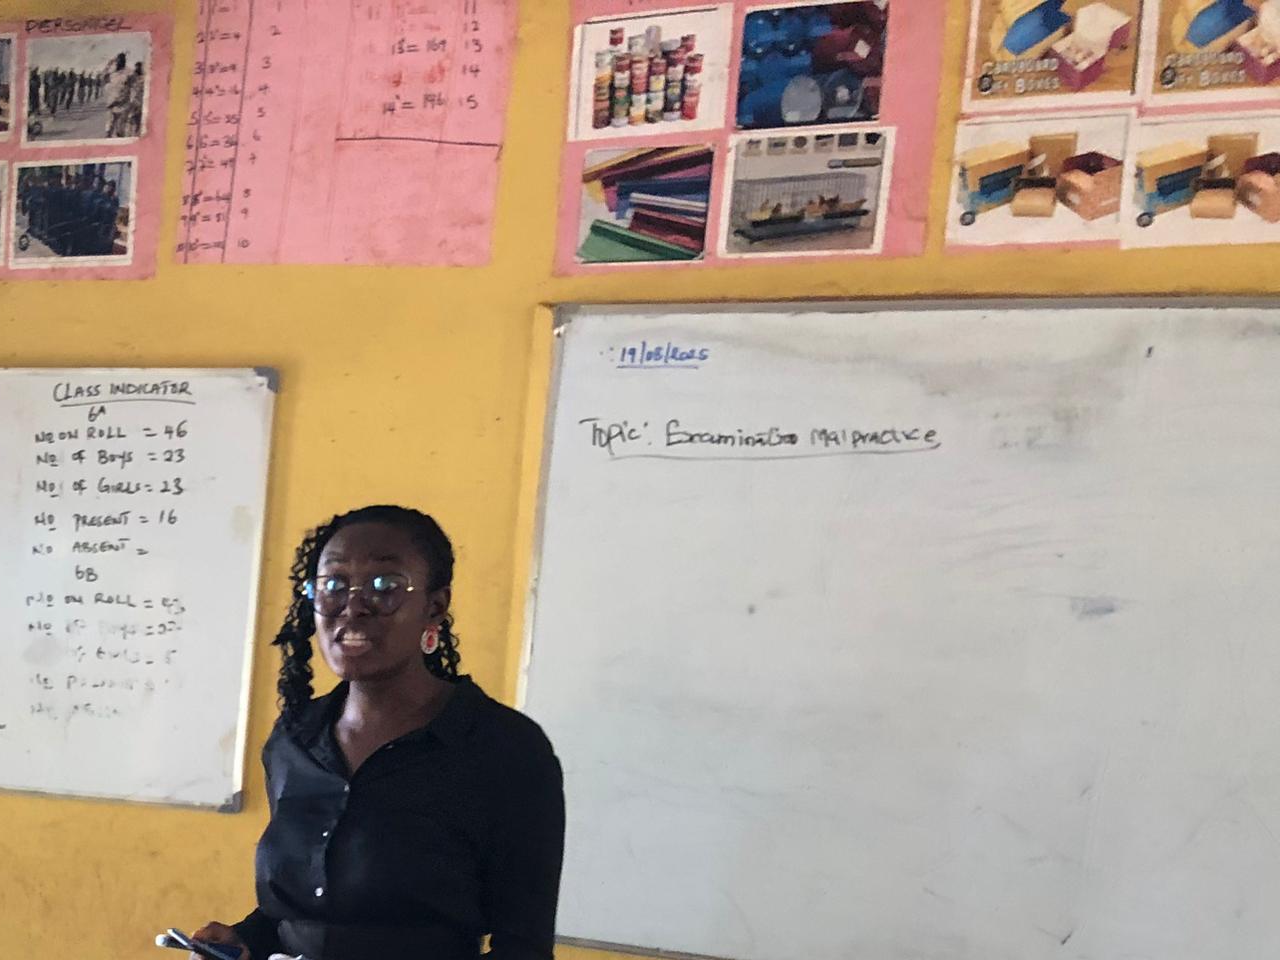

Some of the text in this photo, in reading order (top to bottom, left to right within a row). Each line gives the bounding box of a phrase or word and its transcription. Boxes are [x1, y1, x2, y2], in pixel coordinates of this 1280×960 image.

[462, 64, 481, 77] 14
[53, 380, 192, 402] CLASS INDICATOR
[86, 426, 127, 440] ROLL
[164, 420, 189, 440] 46
[164, 449, 186, 462] 23
[160, 477, 184, 495] 23
[72, 511, 131, 532] PRESENT
[158, 509, 178, 525] 16
[72, 538, 131, 553] ABSENT
[94, 592, 137, 608] ROLL
